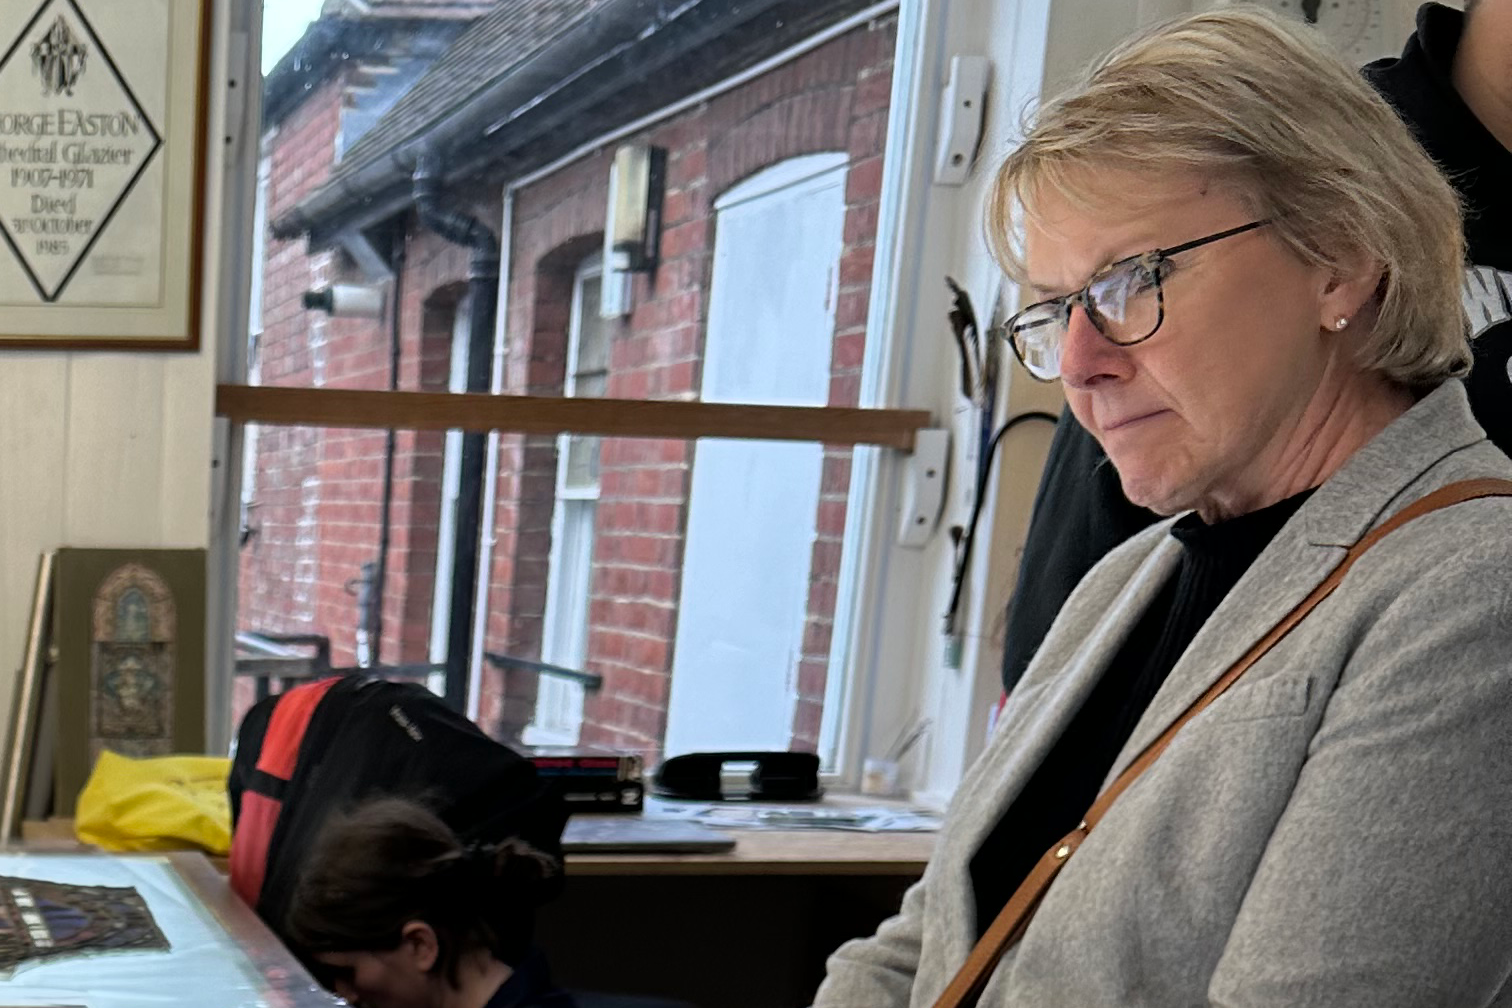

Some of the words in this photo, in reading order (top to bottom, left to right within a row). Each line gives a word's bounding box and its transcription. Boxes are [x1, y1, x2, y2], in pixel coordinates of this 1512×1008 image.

[57, 108, 140, 137] EASTON
[62, 143, 134, 166] Glazier
[31, 194, 77, 215] Died
